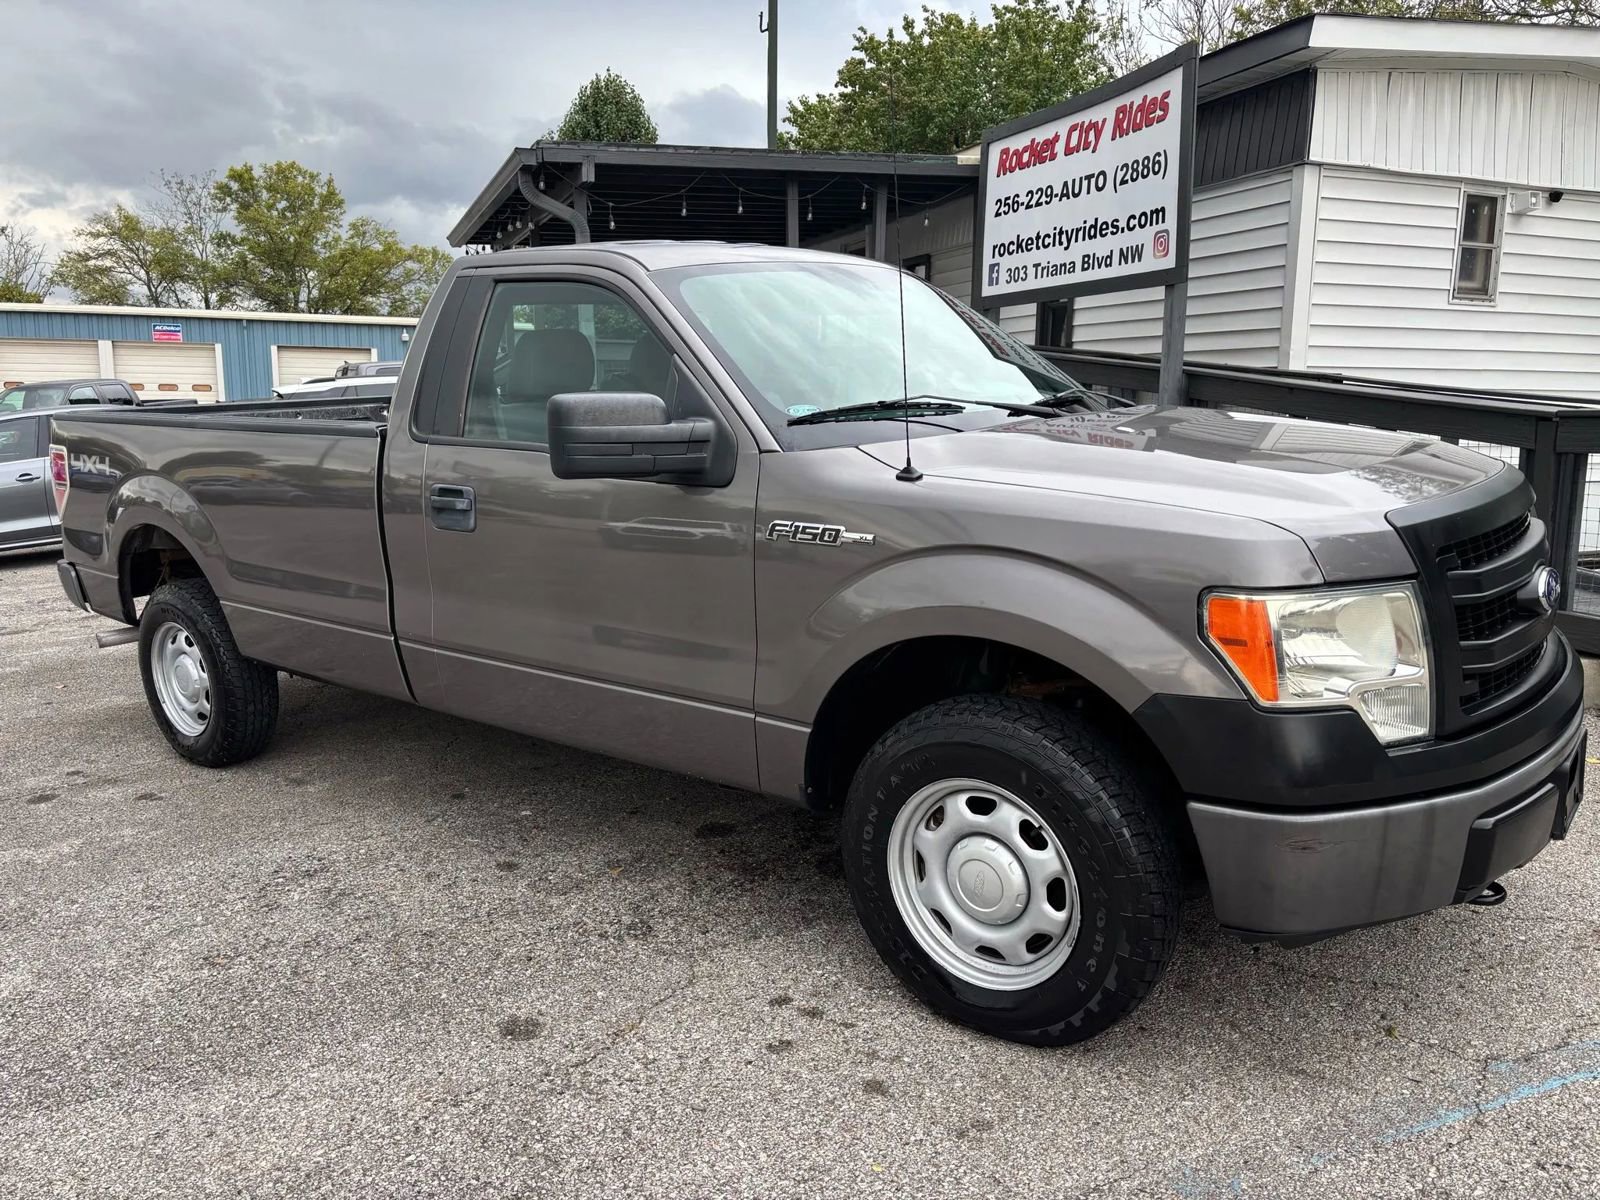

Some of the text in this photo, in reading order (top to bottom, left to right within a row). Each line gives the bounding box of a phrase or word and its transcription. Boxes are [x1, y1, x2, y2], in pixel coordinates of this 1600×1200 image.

[996, 89, 1172, 178] Rocket City Rides
[994, 149, 1168, 218] 256-229-AUTO (2886)
[991, 205, 1166, 259] rocketcityrides.com
[1005, 264, 1028, 285] 303
[1033, 259, 1076, 280] Triana
[1081, 247, 1113, 272] Blvd
[1118, 243, 1145, 266] NW
